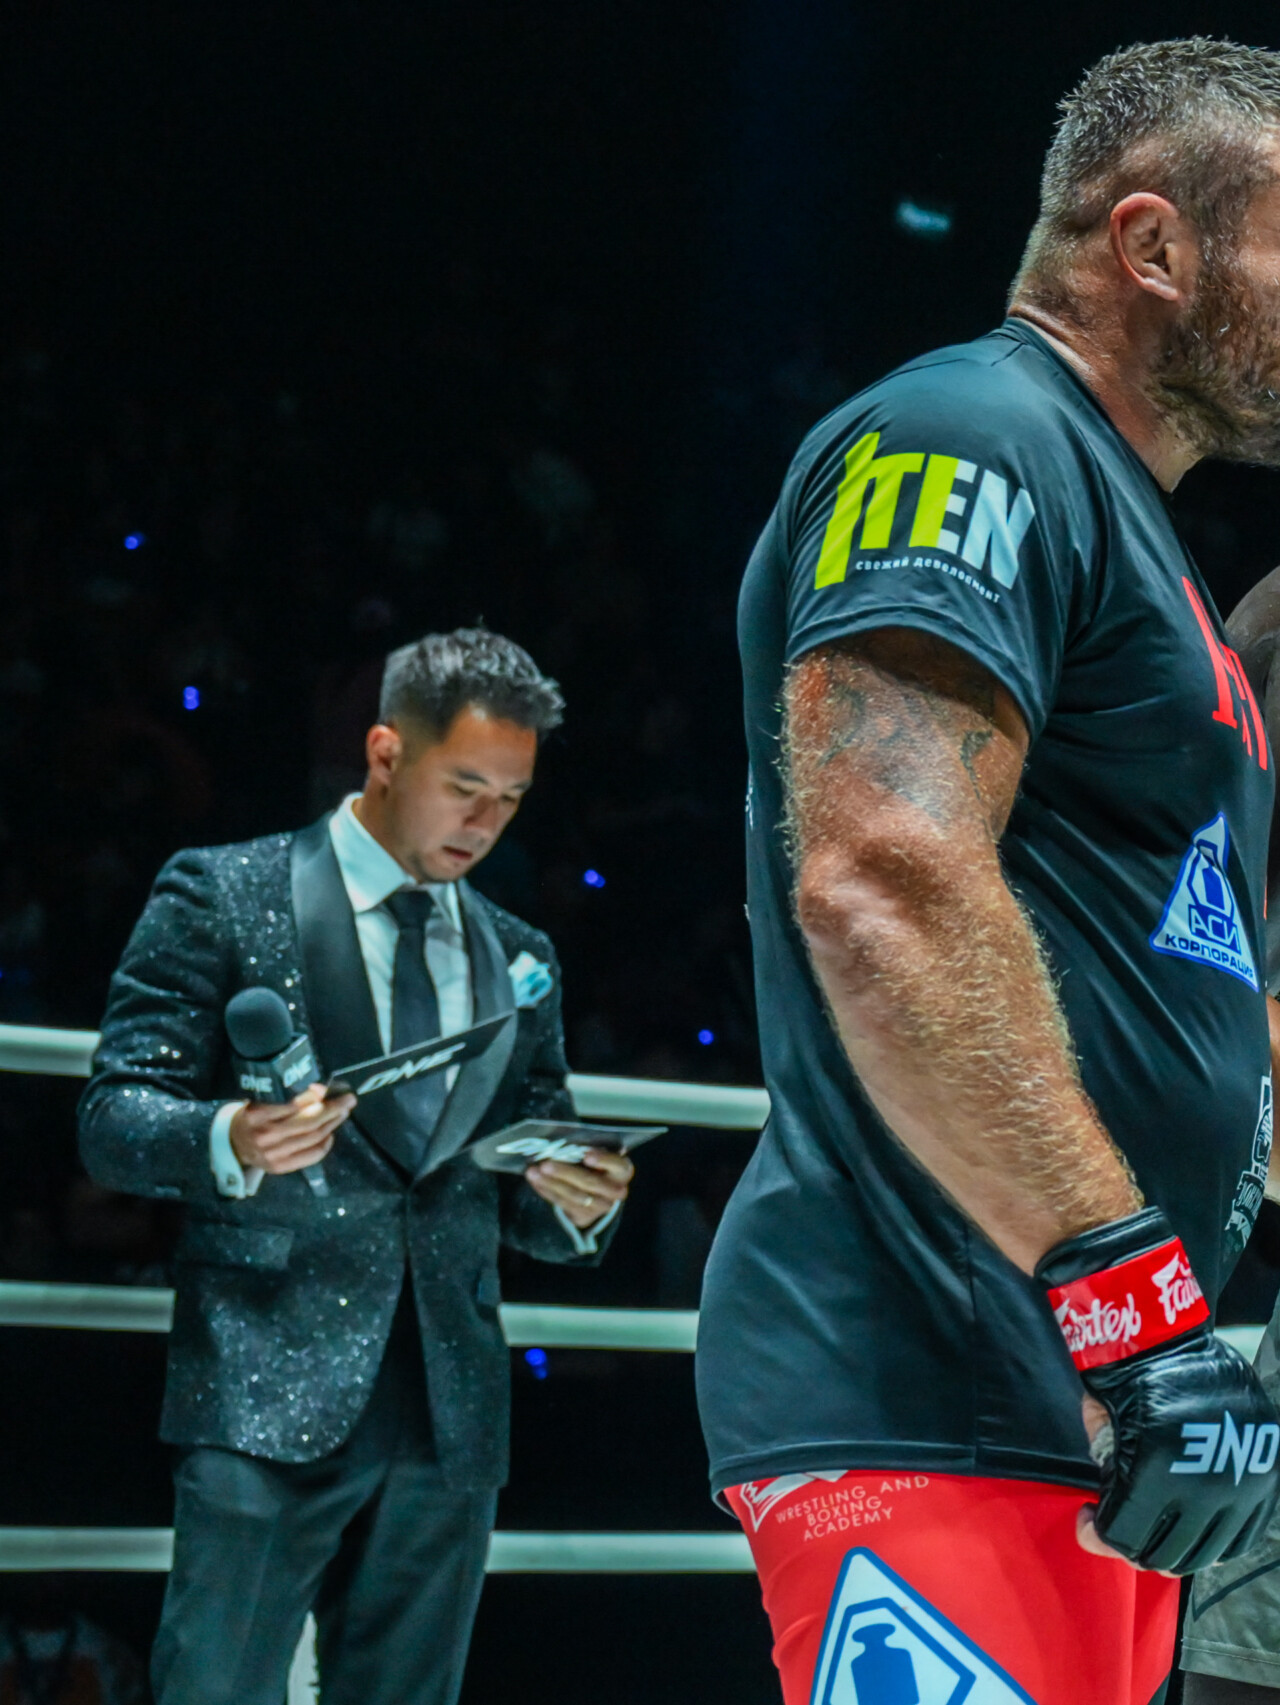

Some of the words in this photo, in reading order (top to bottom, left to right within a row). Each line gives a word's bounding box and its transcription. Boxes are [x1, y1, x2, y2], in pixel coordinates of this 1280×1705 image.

[855, 555, 909, 571] свежий
[240, 1074, 272, 1093] ONE
[357, 1042, 466, 1096] ONE
[1169, 1409, 1280, 1487] ONE
[775, 1485, 867, 1524] WRESTLING
[880, 1475, 930, 1494] AND
[807, 1496, 882, 1527] BOXING
[803, 1507, 893, 1542] ACADEMY
